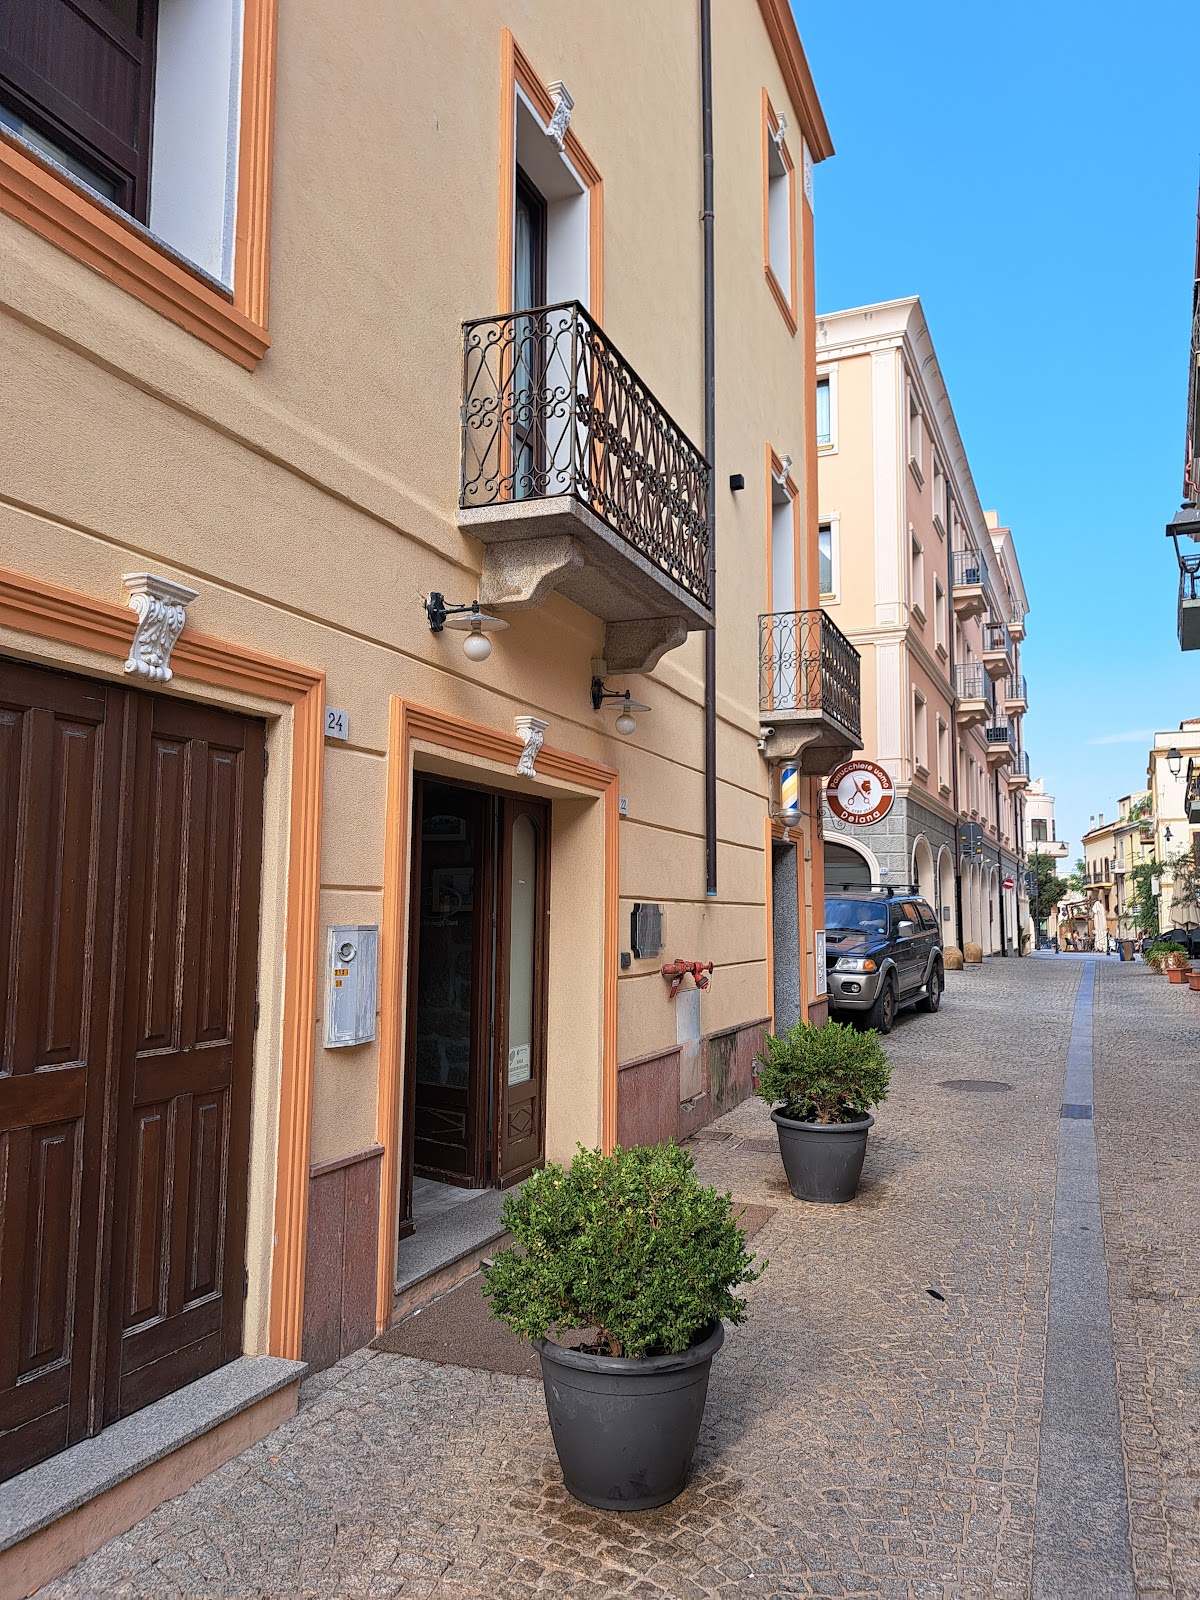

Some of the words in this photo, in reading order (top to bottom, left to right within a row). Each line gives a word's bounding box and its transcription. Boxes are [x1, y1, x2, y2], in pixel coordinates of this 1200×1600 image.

[328, 712, 343, 732] 24
[830, 762, 873, 788] Parrucchiere
[873, 768, 889, 788] uomo
[840, 811, 880, 823] Deiana
